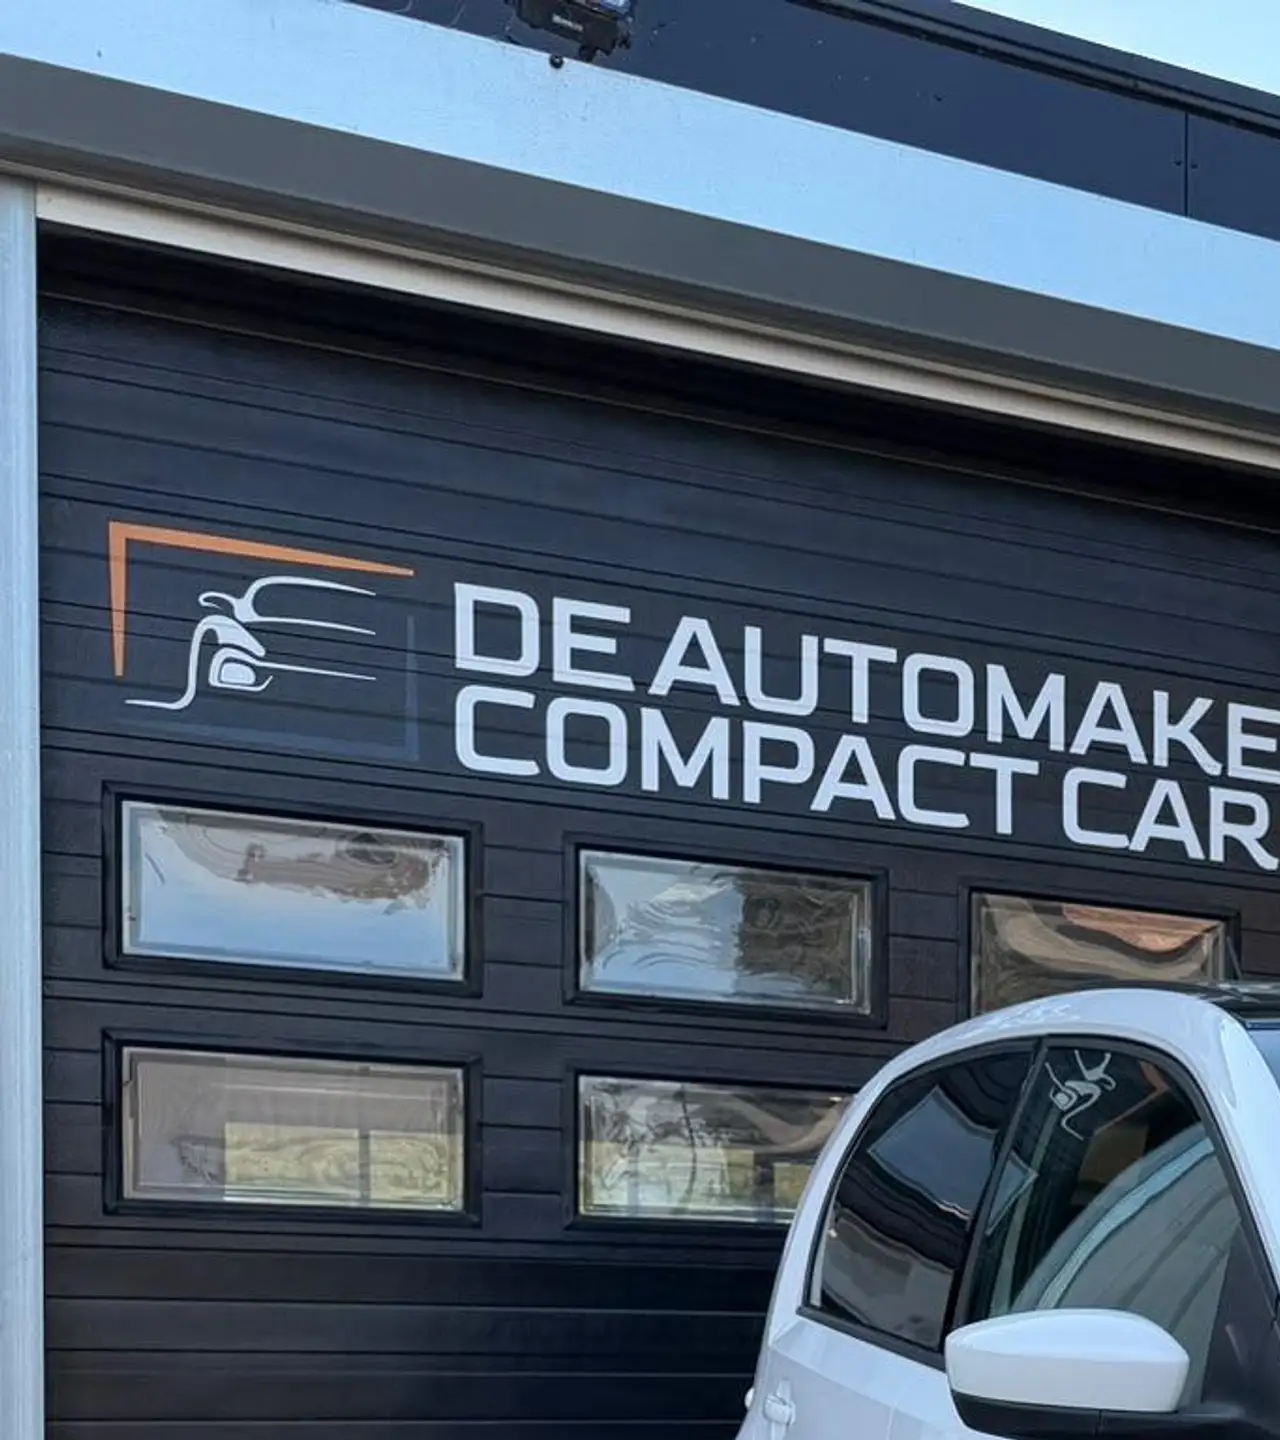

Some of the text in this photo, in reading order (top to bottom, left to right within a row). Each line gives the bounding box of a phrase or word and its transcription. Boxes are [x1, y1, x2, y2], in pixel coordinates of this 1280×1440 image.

[454, 582, 636, 692] DE
[455, 685, 1279, 871] COMPACT CAR
